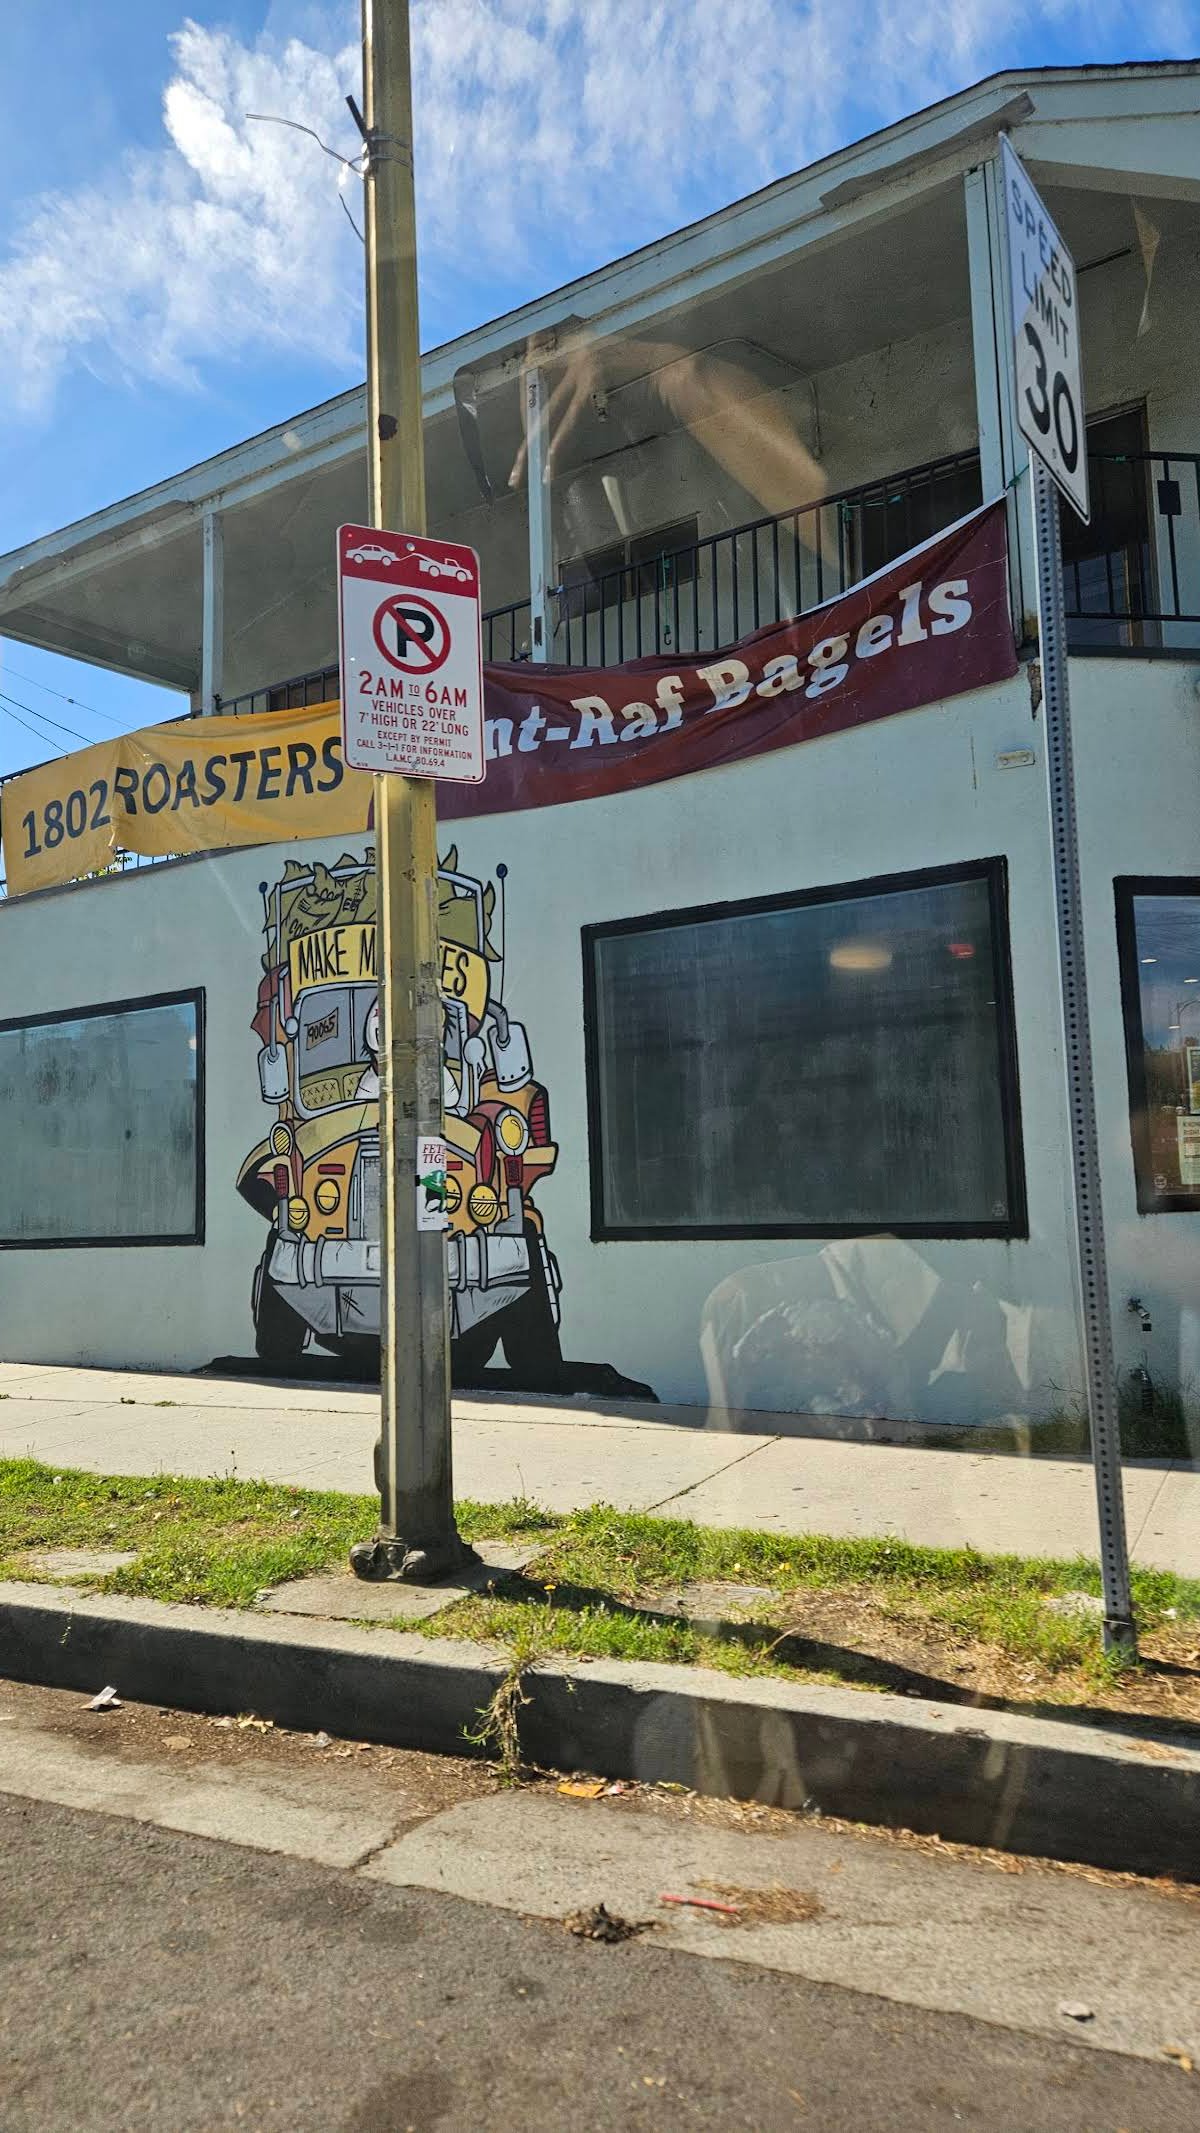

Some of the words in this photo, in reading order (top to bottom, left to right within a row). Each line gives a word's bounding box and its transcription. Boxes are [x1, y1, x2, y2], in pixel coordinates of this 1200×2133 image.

[1012, 179, 1072, 308] SPEED
[1022, 252, 1068, 359] LIMIT
[1024, 321, 1079, 475] 30
[697, 578, 972, 716] Bagels
[358, 670, 403, 699] 2AM
[409, 684, 420, 697] TO
[425, 680, 467, 708] 6AM
[372, 699, 424, 717] VEHICLES
[429, 707, 456, 721] OVER
[371, 713, 398, 727] HIGH
[402, 717, 417, 730] OR
[441, 722, 469, 736] LONG
[377, 730, 407, 741] EXCEPT
[411, 734, 420, 743] BY
[424, 736, 452, 747] PERMIT
[356, 738, 375, 749] CALL
[377, 741, 399, 752] 3-1-1
[401, 744, 417, 754] FOR
[420, 746, 473, 760] INFORMATION
[299, 928, 349, 985] MAKE
